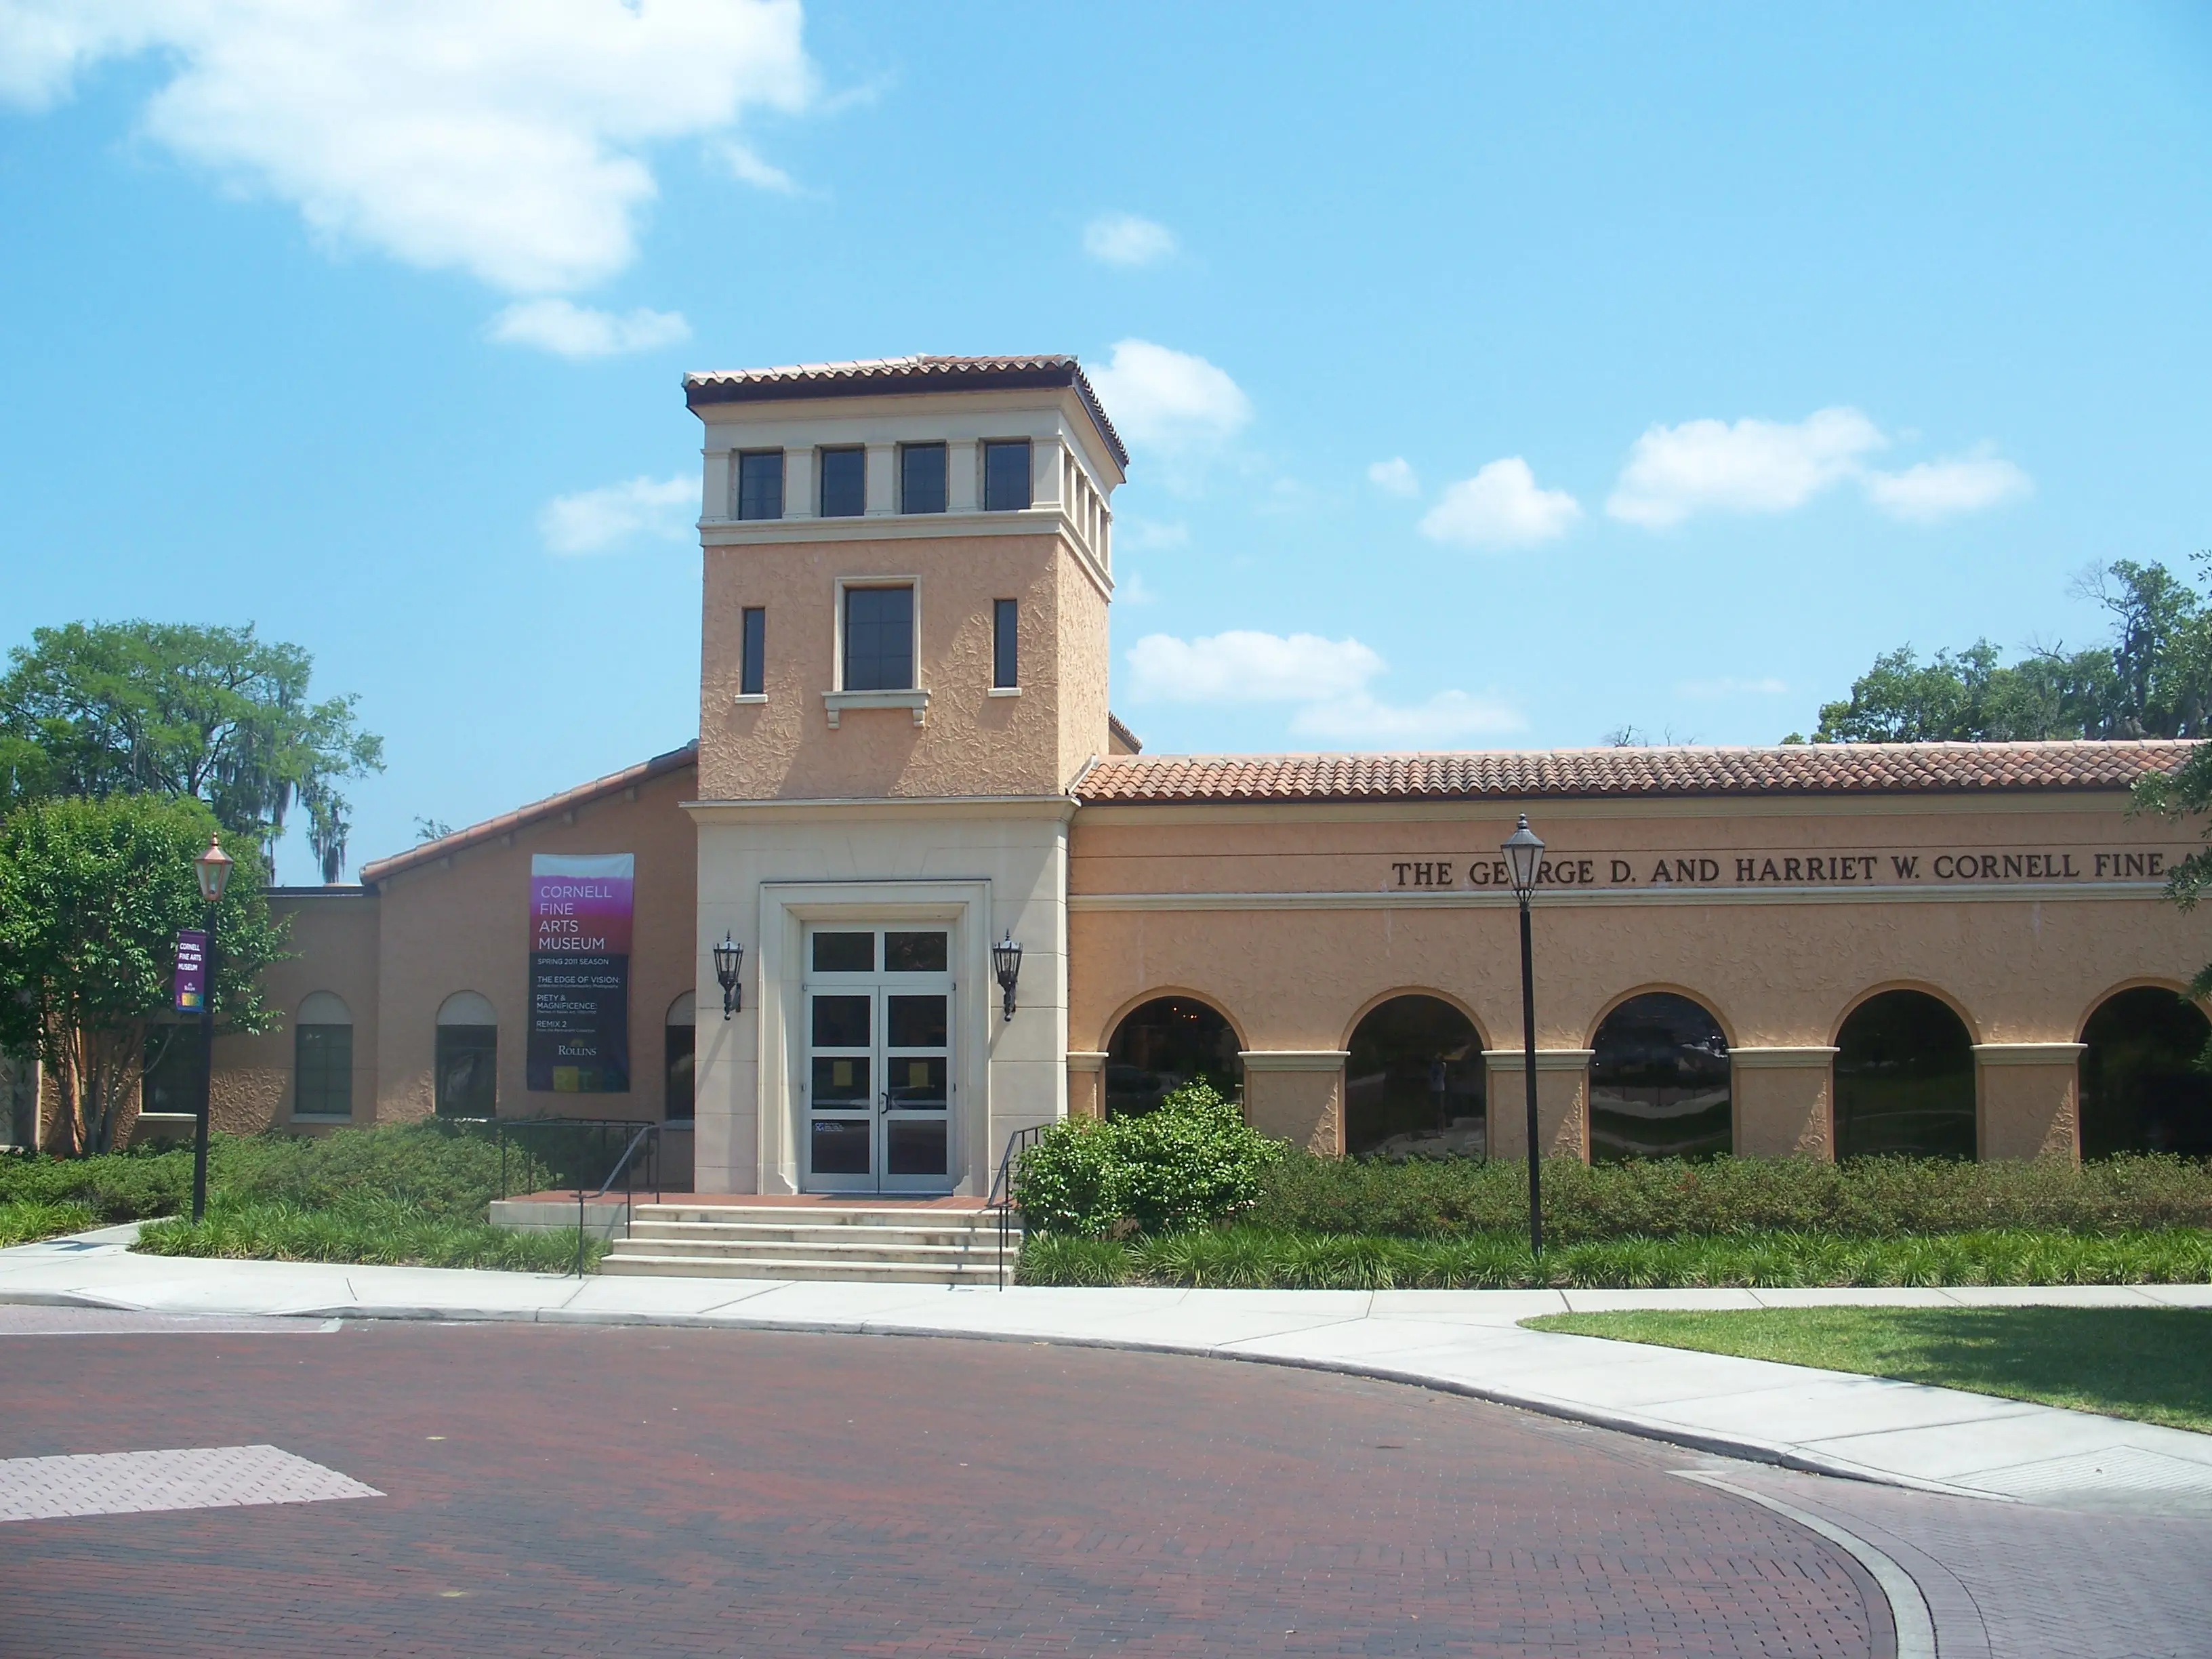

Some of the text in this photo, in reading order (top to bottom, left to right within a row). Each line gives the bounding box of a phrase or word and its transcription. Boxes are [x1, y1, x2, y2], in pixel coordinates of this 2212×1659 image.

[1392, 862, 1452, 885] THE
[1469, 861, 1594, 884] GERGE
[1611, 859, 1636, 882] D.
[1652, 859, 1719, 882] AND
[1736, 856, 1877, 881] HARRIET
[1891, 855, 1919, 879] W.
[1933, 854, 2080, 878] CORNELL
[2093, 853, 2163, 876] FINE
[541, 886, 612, 898] CORNELL
[540, 903, 573, 915] FINE
[539, 920, 578, 933] ARTS
[180, 943, 201, 951] CORNELL
[539, 937, 605, 949] MUSEUM
[590, 976, 621, 984] VISION:
